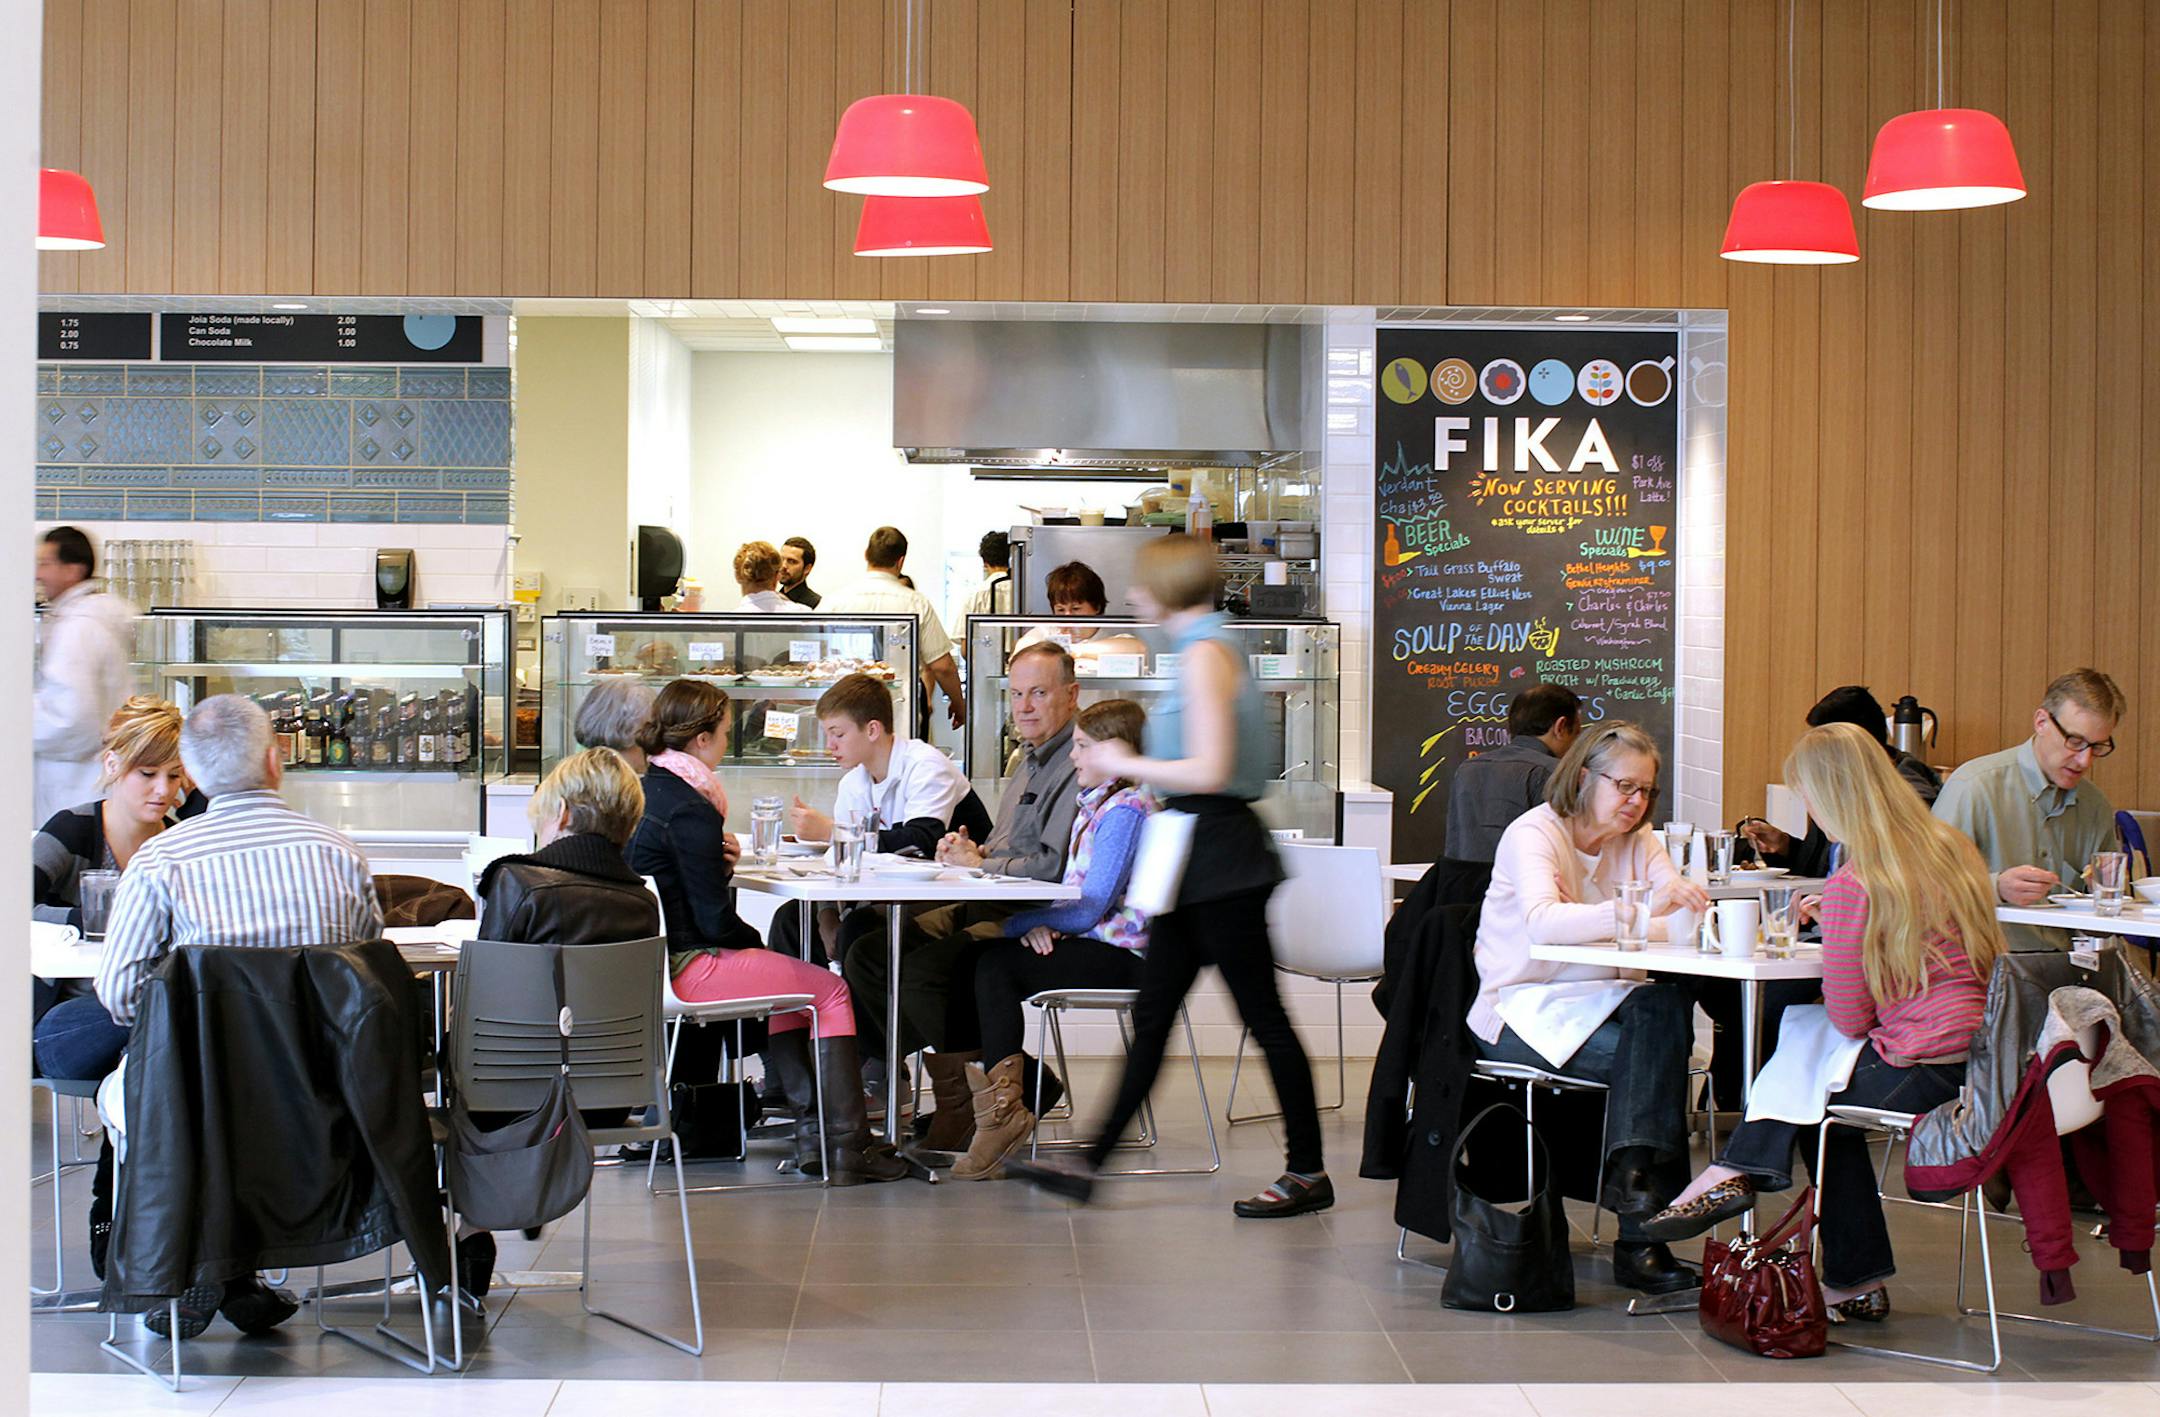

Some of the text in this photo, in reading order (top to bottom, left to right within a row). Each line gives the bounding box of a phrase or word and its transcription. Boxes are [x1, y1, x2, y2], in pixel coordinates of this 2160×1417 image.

[60, 319, 79, 327] 1.75
[209, 316, 232, 324] Soda
[233, 316, 261, 325] (made
[262, 316, 294, 326] locally)
[337, 316, 356, 325] 2.00
[60, 330, 79, 338] 2.00
[188, 327, 356, 336] Can Soda 1.00
[60, 341, 79, 350] 0.75
[188, 338, 356, 347] Chocolate Milk 1.00
[1434, 416, 1620, 472] FIKA
[1632, 475, 1654, 490] Park
[1515, 518, 1537, 530] your
[1537, 518, 1566, 526] server
[1405, 520, 1452, 547] BEER
[1424, 533, 1471, 557] Specials
[1580, 542, 1628, 559] Specials
[1443, 563, 1474, 575] Grass
[1477, 560, 1521, 574] Buffalo
[1413, 587, 1443, 600] Great
[1446, 587, 1477, 599] Lakes
[1440, 599, 1505, 615] Vienna Lager
[1393, 622, 1462, 661] SOUP
[1486, 622, 1531, 653] DAY
[1594, 658, 1664, 672] MUSHROOM
